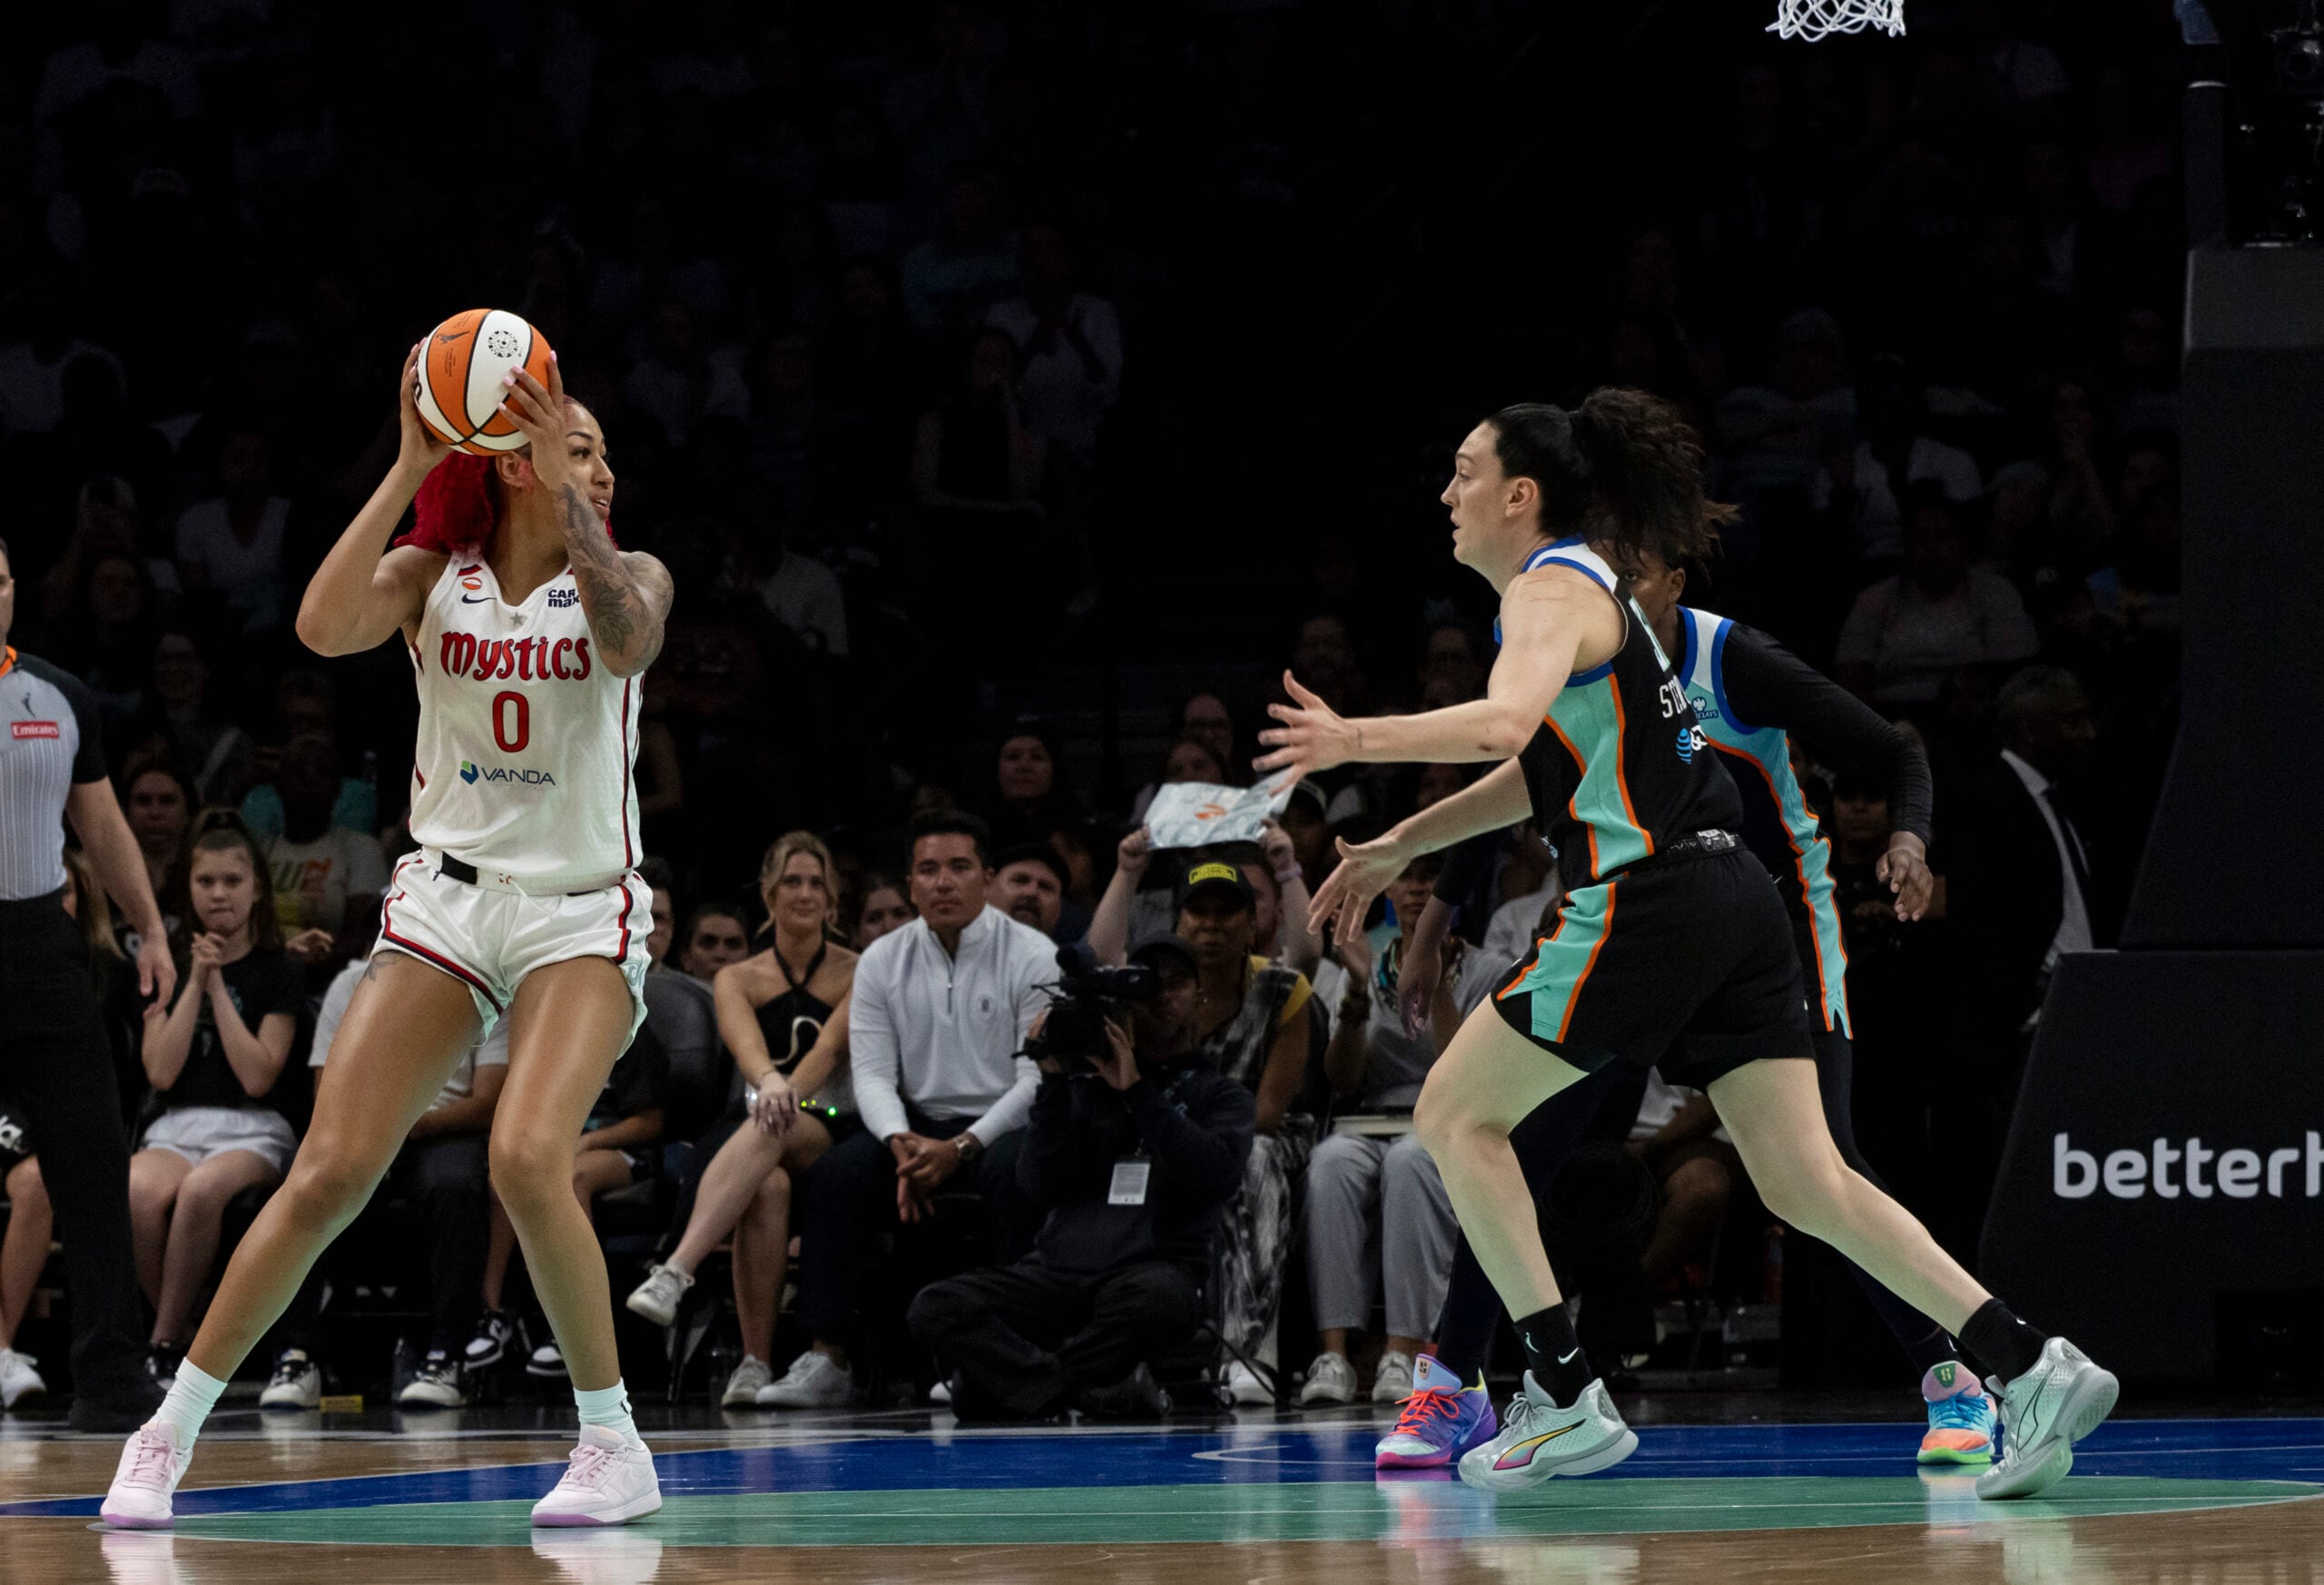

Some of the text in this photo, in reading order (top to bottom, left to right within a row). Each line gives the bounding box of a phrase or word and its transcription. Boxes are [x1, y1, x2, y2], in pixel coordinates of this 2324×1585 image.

[12, 724, 58, 736] Emirates
[492, 691, 529, 753] 0
[481, 767, 556, 786] VANDA
